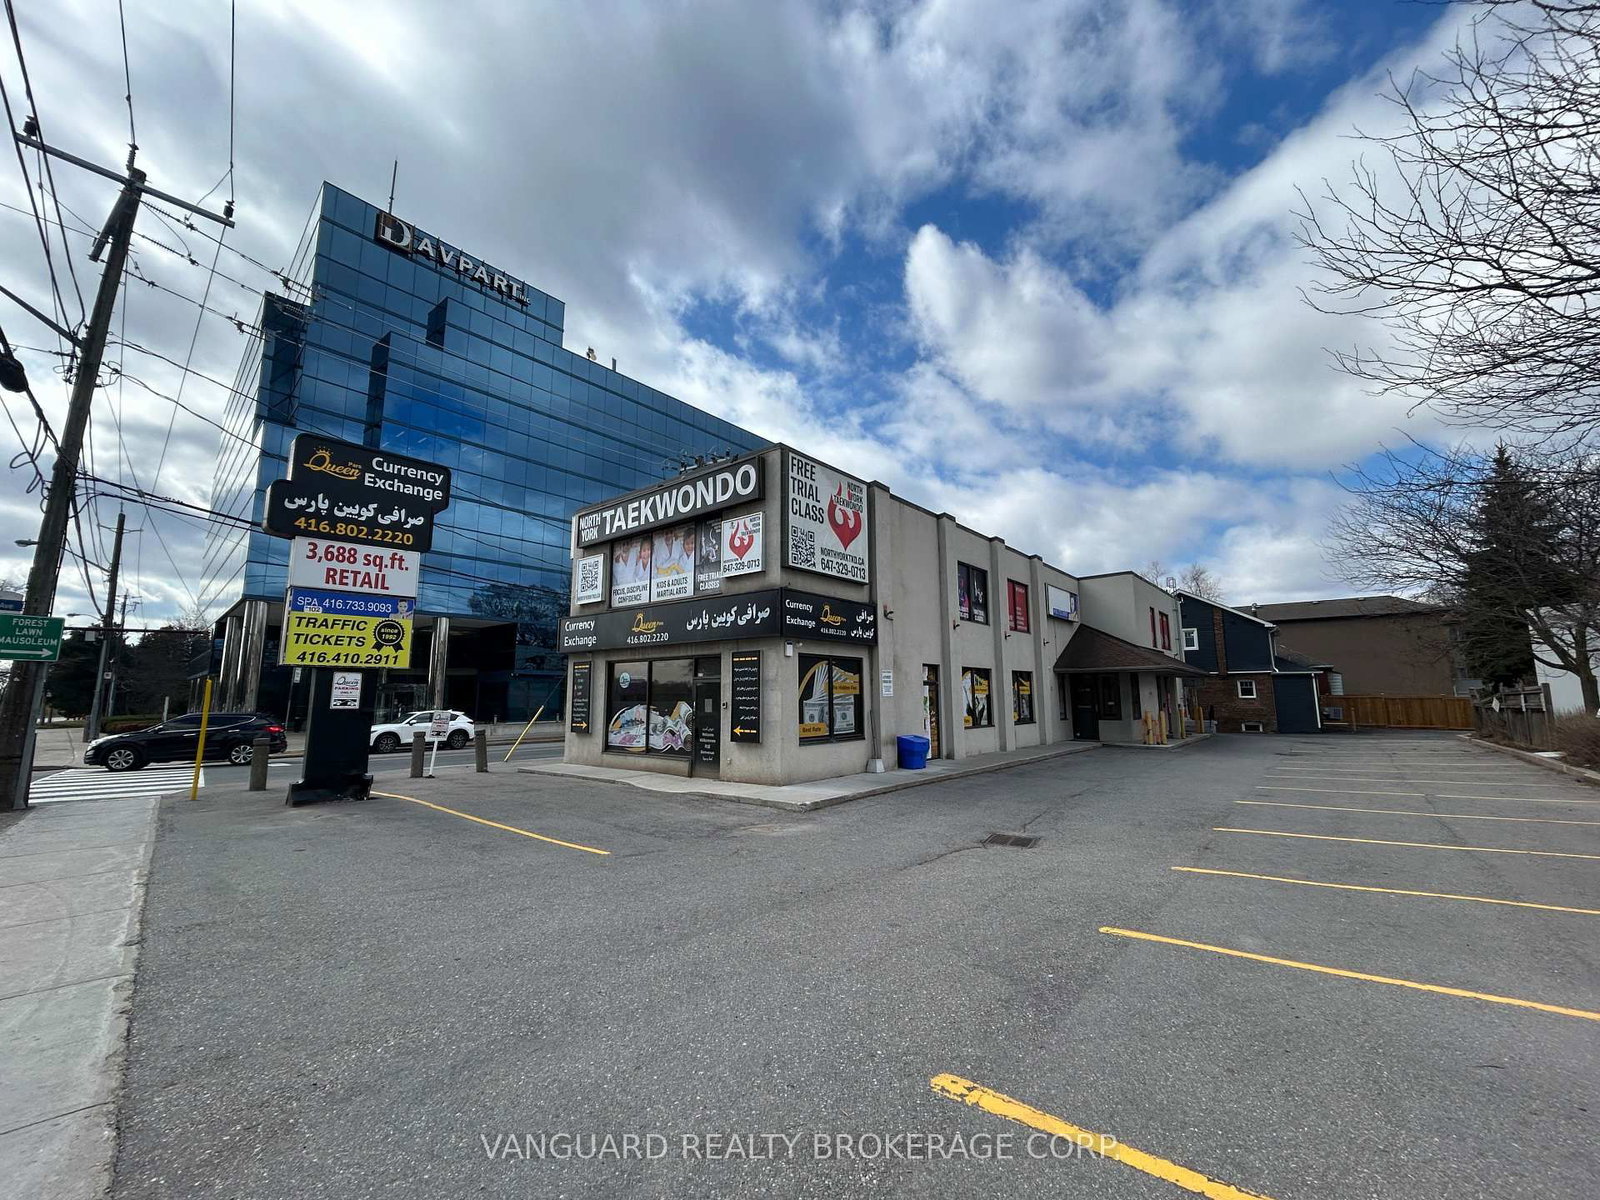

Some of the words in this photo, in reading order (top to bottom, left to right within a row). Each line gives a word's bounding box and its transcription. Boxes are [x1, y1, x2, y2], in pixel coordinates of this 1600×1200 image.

[380, 214, 522, 297] DAVPART
[304, 452, 361, 480] Queen
[371, 457, 444, 486] Currency
[791, 456, 816, 482] FREE
[364, 472, 443, 502] Exchange
[791, 476, 821, 503] TRIAL
[284, 493, 329, 516] پارس
[602, 464, 757, 535] TAEKWONDO
[377, 506, 425, 529] صرافی
[791, 498, 825, 524] CLASS
[294, 516, 414, 545] 416.802.2220
[579, 513, 601, 531] NORTH
[581, 527, 598, 543] YORK
[306, 542, 358, 565] 3,688
[362, 551, 409, 573] sq.ft.
[723, 559, 760, 573] 647-329-0713
[820, 558, 866, 580] 647-329-0713
[324, 567, 390, 591] RETAIL
[656, 580, 667, 589] KIDS
[671, 577, 688, 586] ADULTS
[656, 588, 676, 598] MARTIAL
[675, 587, 688, 595] ARTS
[296, 596, 319, 606] SPA
[323, 599, 392, 613] 416.733.9093
[785, 599, 813, 612] Currency
[12, 618, 49, 627] FOREST
[295, 616, 368, 631] TRAFFIC
[686, 609, 709, 630] پارس
[737, 603, 770, 626] صرافی
[786, 615, 816, 628] Exchange
[15, 628, 43, 636] LAWN
[565, 620, 595, 632] Currency
[293, 633, 366, 647] TICKETS
[564, 634, 597, 647] Exchange
[627, 633, 669, 644] 416.802.2220
[297, 652, 399, 665] 416.410.2911
